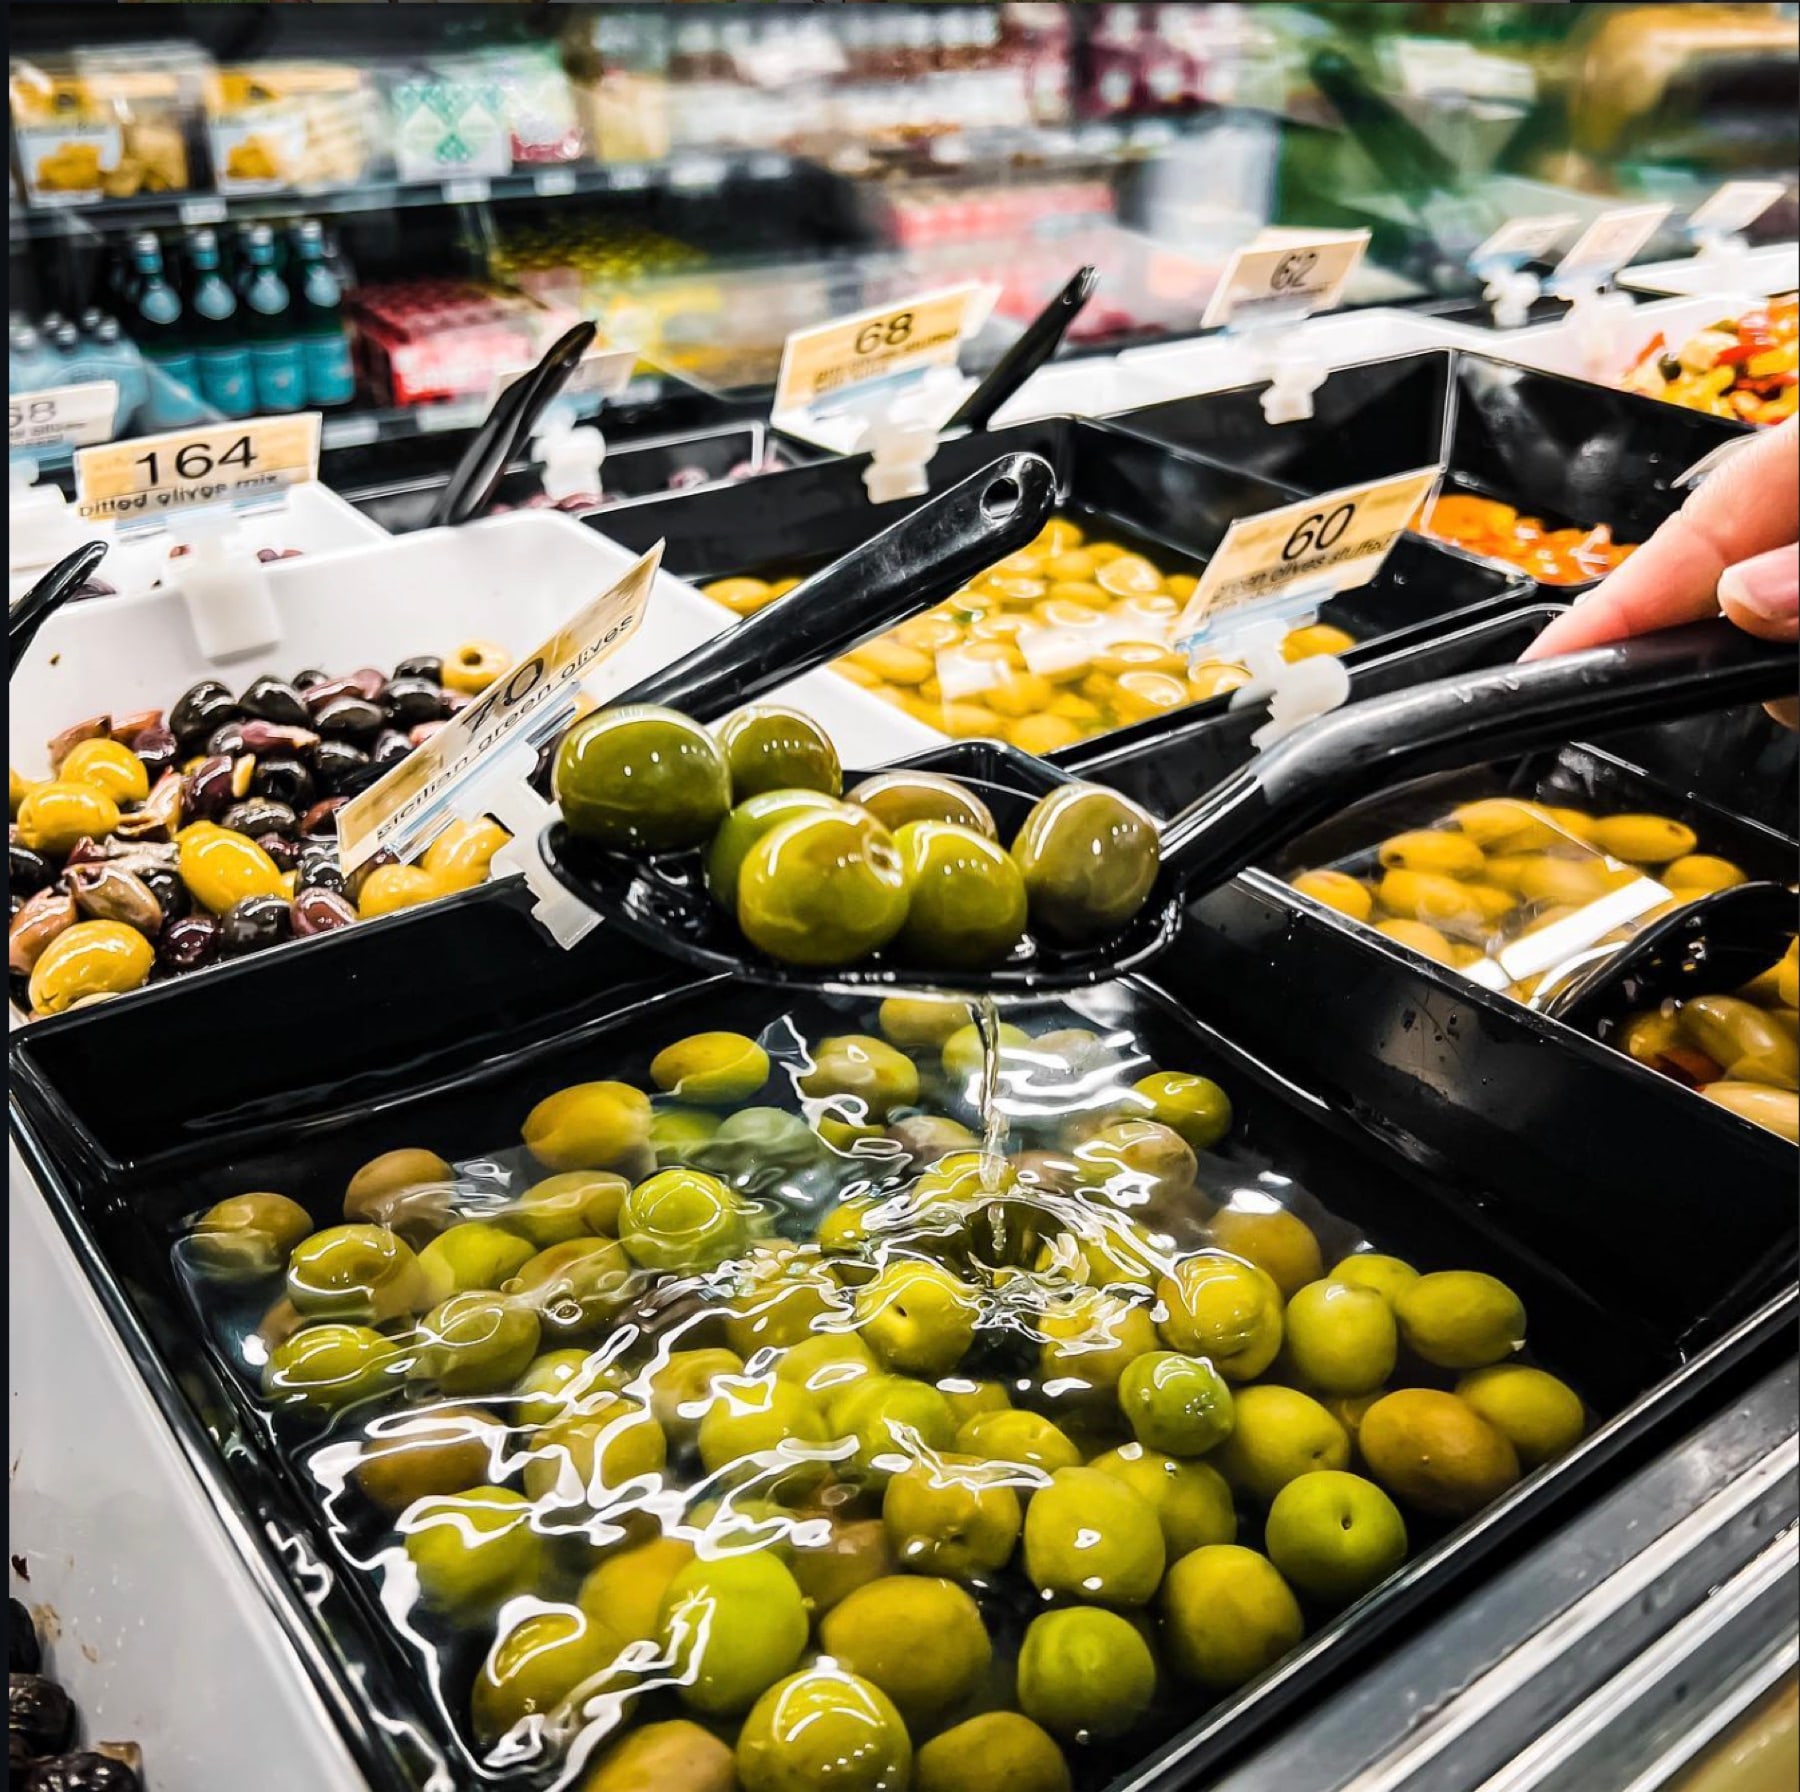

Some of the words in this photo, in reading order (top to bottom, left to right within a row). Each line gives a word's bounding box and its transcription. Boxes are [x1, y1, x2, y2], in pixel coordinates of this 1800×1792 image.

[1270, 251, 1320, 290] 62
[855, 312, 914, 355] 68
[136, 435, 258, 486] 164
[157, 483, 228, 506] olives
[235, 473, 279, 490] mix
[1281, 503, 1356, 561] 60
[461, 657, 545, 734] 70
[376, 755, 469, 841] sicilian
[478, 683, 551, 752] green
[560, 614, 634, 680] olives
